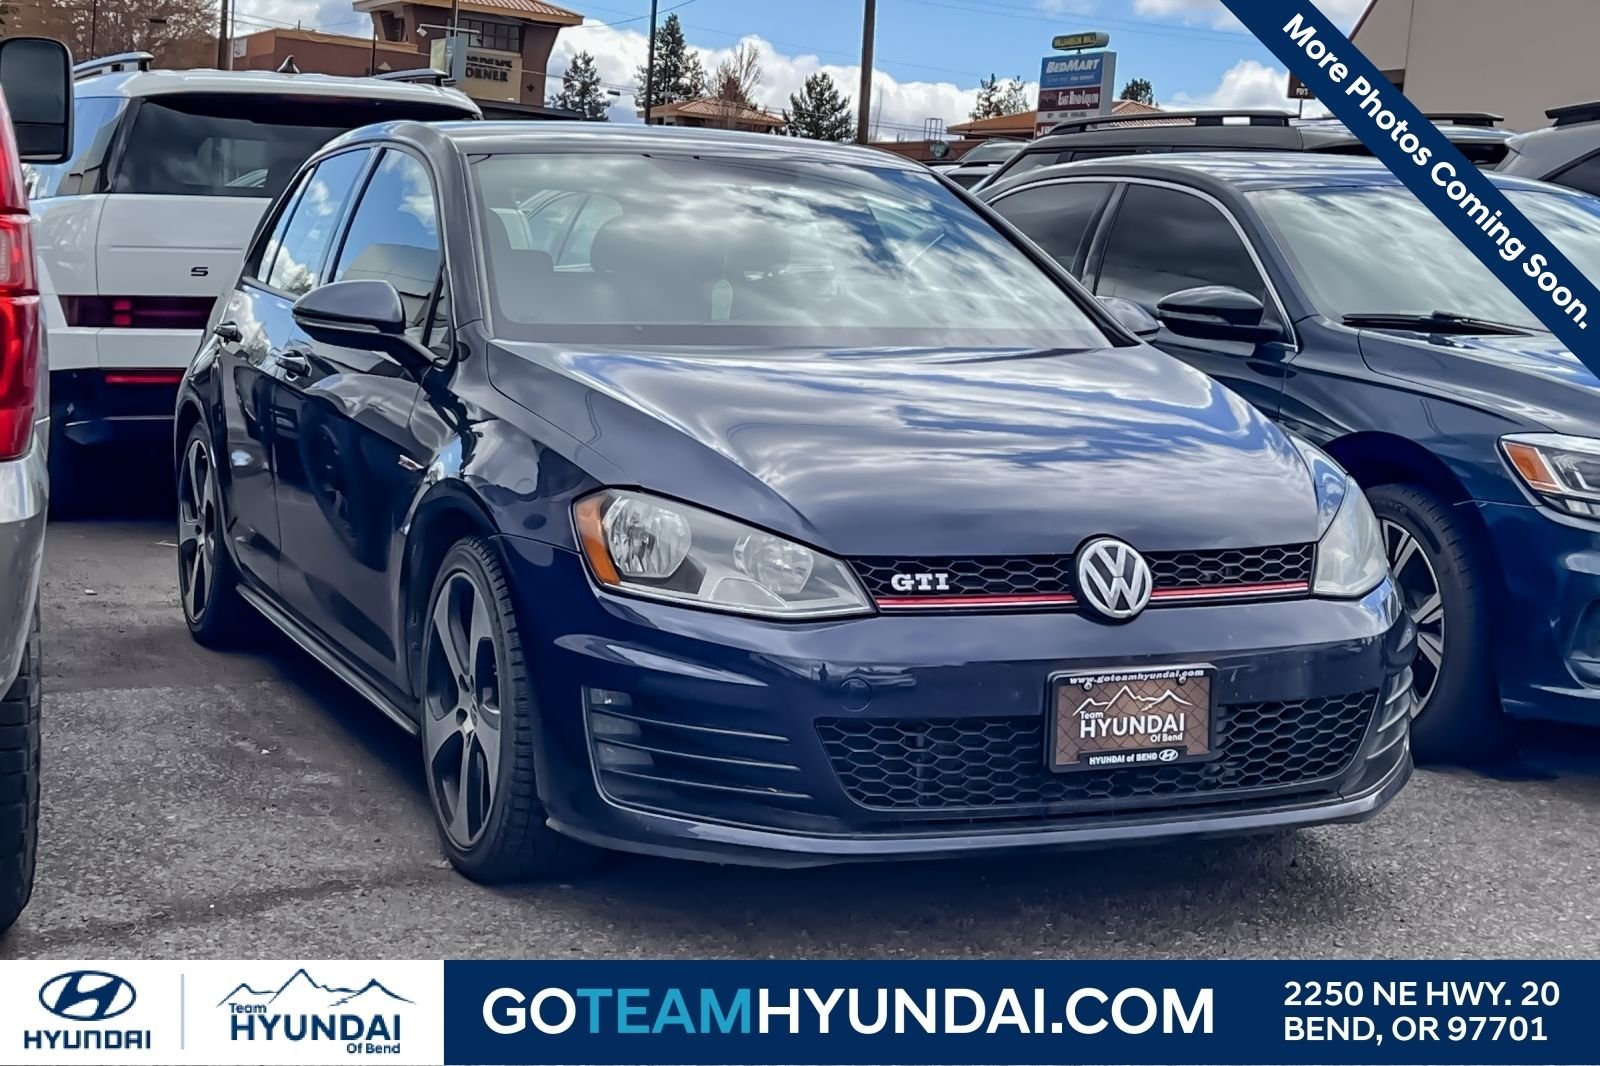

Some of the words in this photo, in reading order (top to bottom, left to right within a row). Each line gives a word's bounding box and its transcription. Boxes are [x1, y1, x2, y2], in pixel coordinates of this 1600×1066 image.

[465, 67, 508, 82] ORNER
[190, 266, 209, 277] S
[891, 573, 950, 591] GTI
[1069, 669, 1205, 685] www.goteamhyundai.com
[1079, 710, 1104, 720] Team
[1080, 712, 1185, 739] HYUNDAI
[1150, 733, 1161, 743] Of
[1162, 732, 1183, 743] Bend
[1089, 755, 1125, 766] HYUNDAI
[1126, 753, 1135, 763] of
[1136, 752, 1158, 762] BEND
